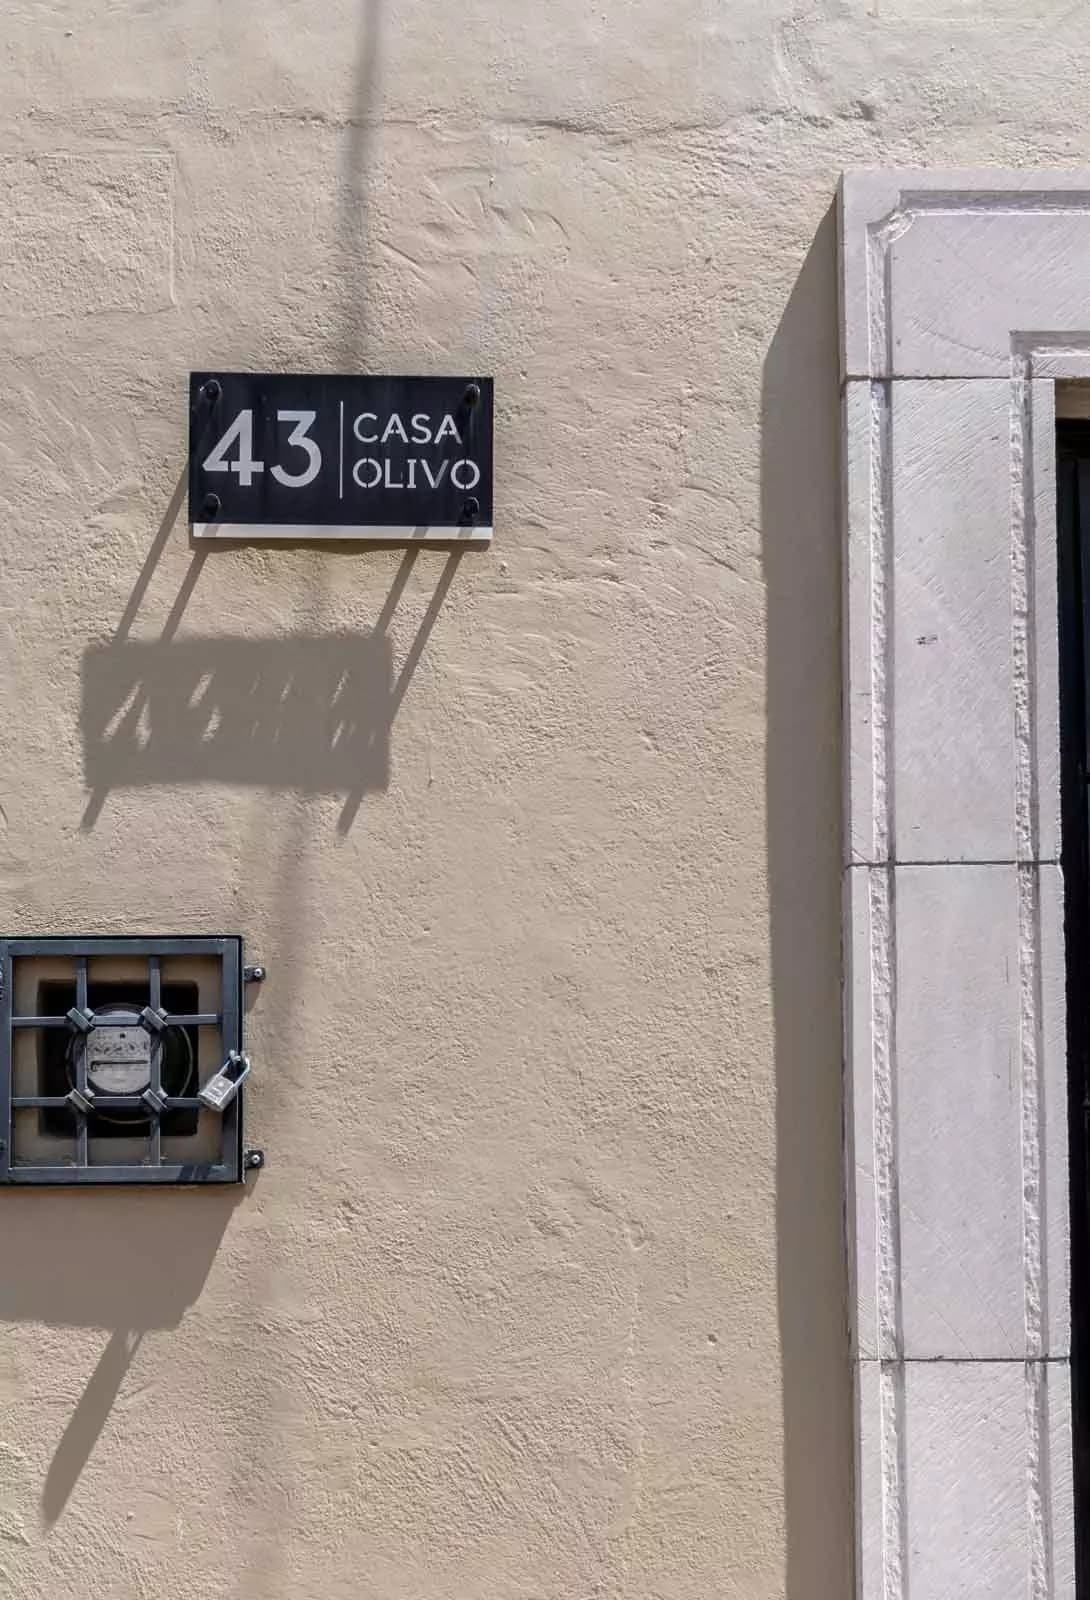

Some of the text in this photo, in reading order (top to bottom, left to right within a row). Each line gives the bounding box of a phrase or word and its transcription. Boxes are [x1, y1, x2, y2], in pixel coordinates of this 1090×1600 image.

[353, 412, 463, 445] CASA
[201, 409, 322, 488] 43
[352, 458, 481, 490] OLIVO
